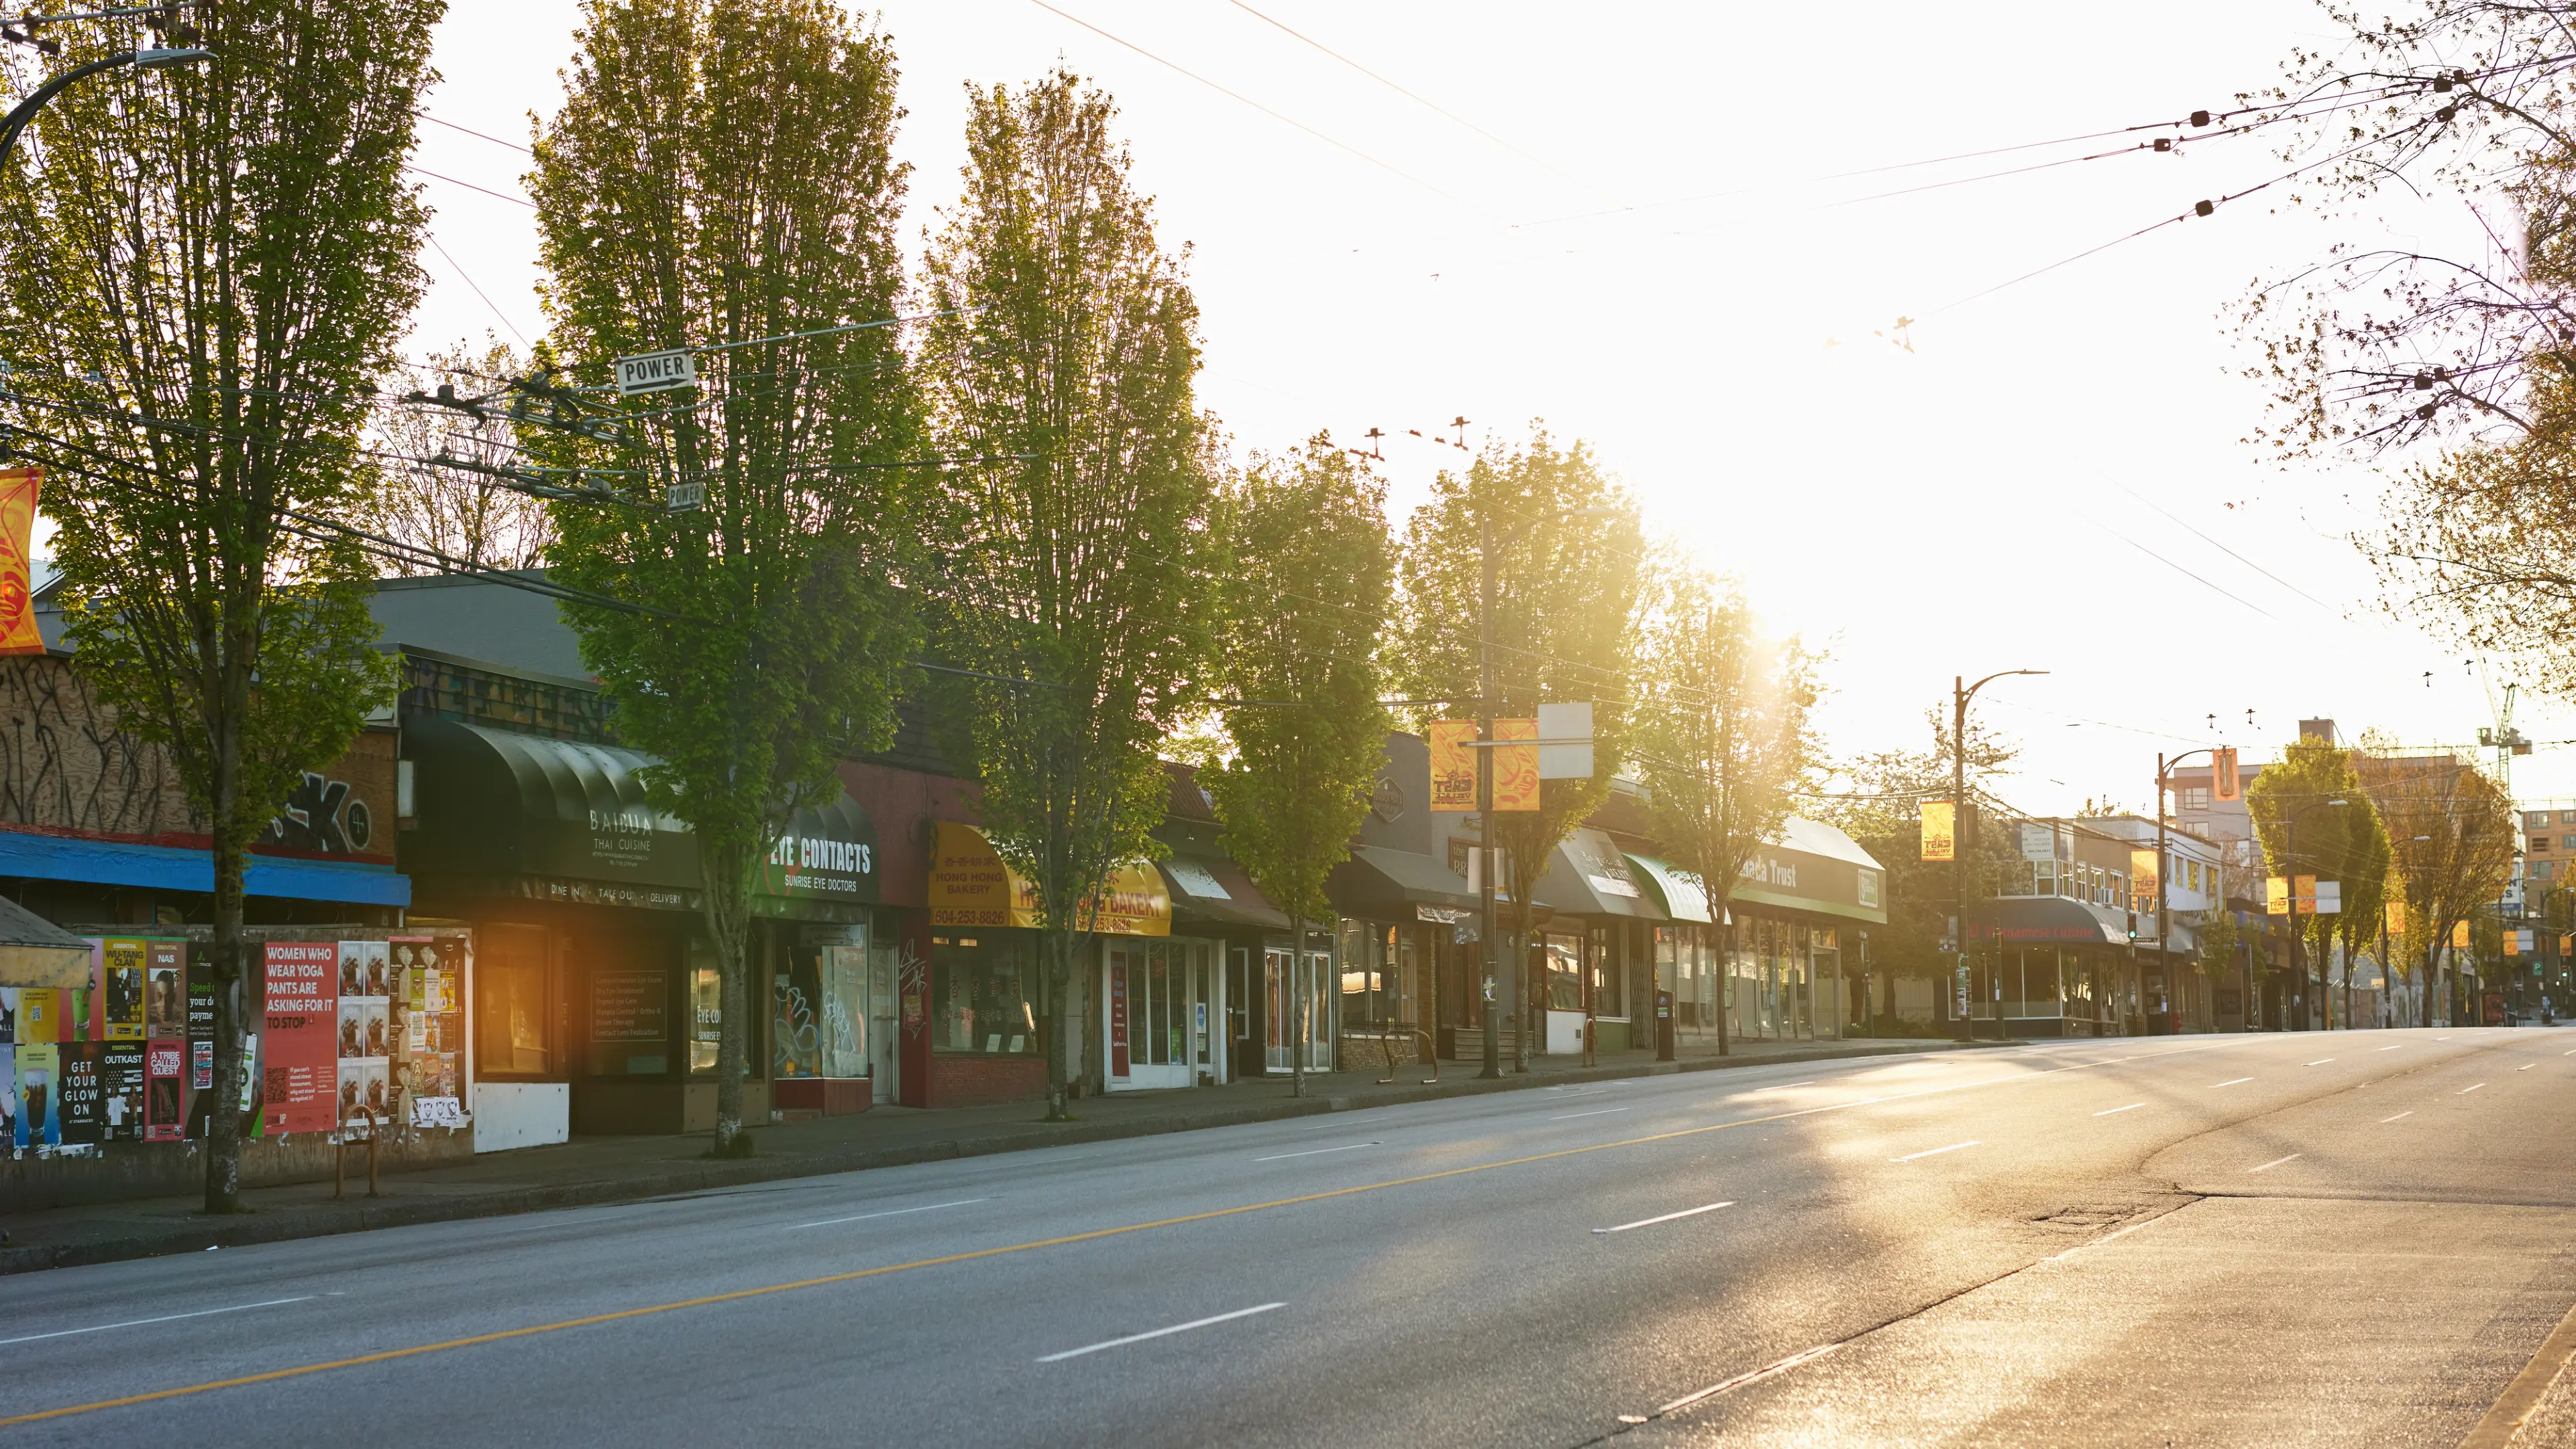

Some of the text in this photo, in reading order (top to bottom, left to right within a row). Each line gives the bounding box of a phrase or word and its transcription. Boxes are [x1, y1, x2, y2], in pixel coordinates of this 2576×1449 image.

[625, 356, 685, 382] POWER
[671, 485, 700, 504] POWER
[590, 810, 653, 836] BAIBUA
[594, 839, 651, 851] THAI CUISINE
[1453, 845, 1465, 857] the
[770, 836, 871, 874] EYE CONTACTS
[936, 873, 1002, 882] HONG HONG
[1770, 859, 1796, 888] Trust
[785, 875, 857, 892] SUNRISE EYE DOCTORS
[947, 885, 991, 894] BAKERY
[551, 883, 568, 896] DINE
[571, 886, 580, 896] IN
[599, 888, 616, 898] TAKE
[650, 893, 681, 904] DELIVERY
[1110, 892, 1160, 917] BAKERY
[936, 910, 1004, 924] 604-253-8826
[2054, 925, 2094, 938] Cuisine
[106, 950, 144, 959] WU-TANG
[158, 955, 174, 963] NAS
[267, 947, 306, 960] WOMEN
[307, 948, 332, 960] WHO
[114, 958, 136, 967] CLAN
[267, 965, 324, 977] WEAR YOGA
[638, 976, 647, 984] Eye
[190, 983, 210, 994] Speed
[267, 982, 317, 994] PANTS ARE
[596, 987, 605, 996] Dry
[606, 987, 616, 996] Eye
[189, 998, 206, 1008] your
[267, 999, 333, 1012] ASKING FOR IT
[616, 998, 625, 1006] Eye
[189, 1011, 213, 1022] payme
[596, 1008, 615, 1016] Myopia
[616, 1007, 636, 1015] Control
[697, 1009, 710, 1024] EYE
[267, 1017, 306, 1029] TO STOP
[613, 1019, 635, 1027] Therapy
[698, 1031, 716, 1040] SUNRISE
[105, 1055, 143, 1065] OUTKAST
[150, 1051, 180, 1060] A TRIBE
[71, 1061, 92, 1073] GET
[150, 1059, 180, 1068] CALLED
[152, 1067, 179, 1075] QUEST
[66, 1075, 97, 1087] YOUR
[65, 1089, 98, 1102] GLOW
[73, 1104, 89, 1115] ON
